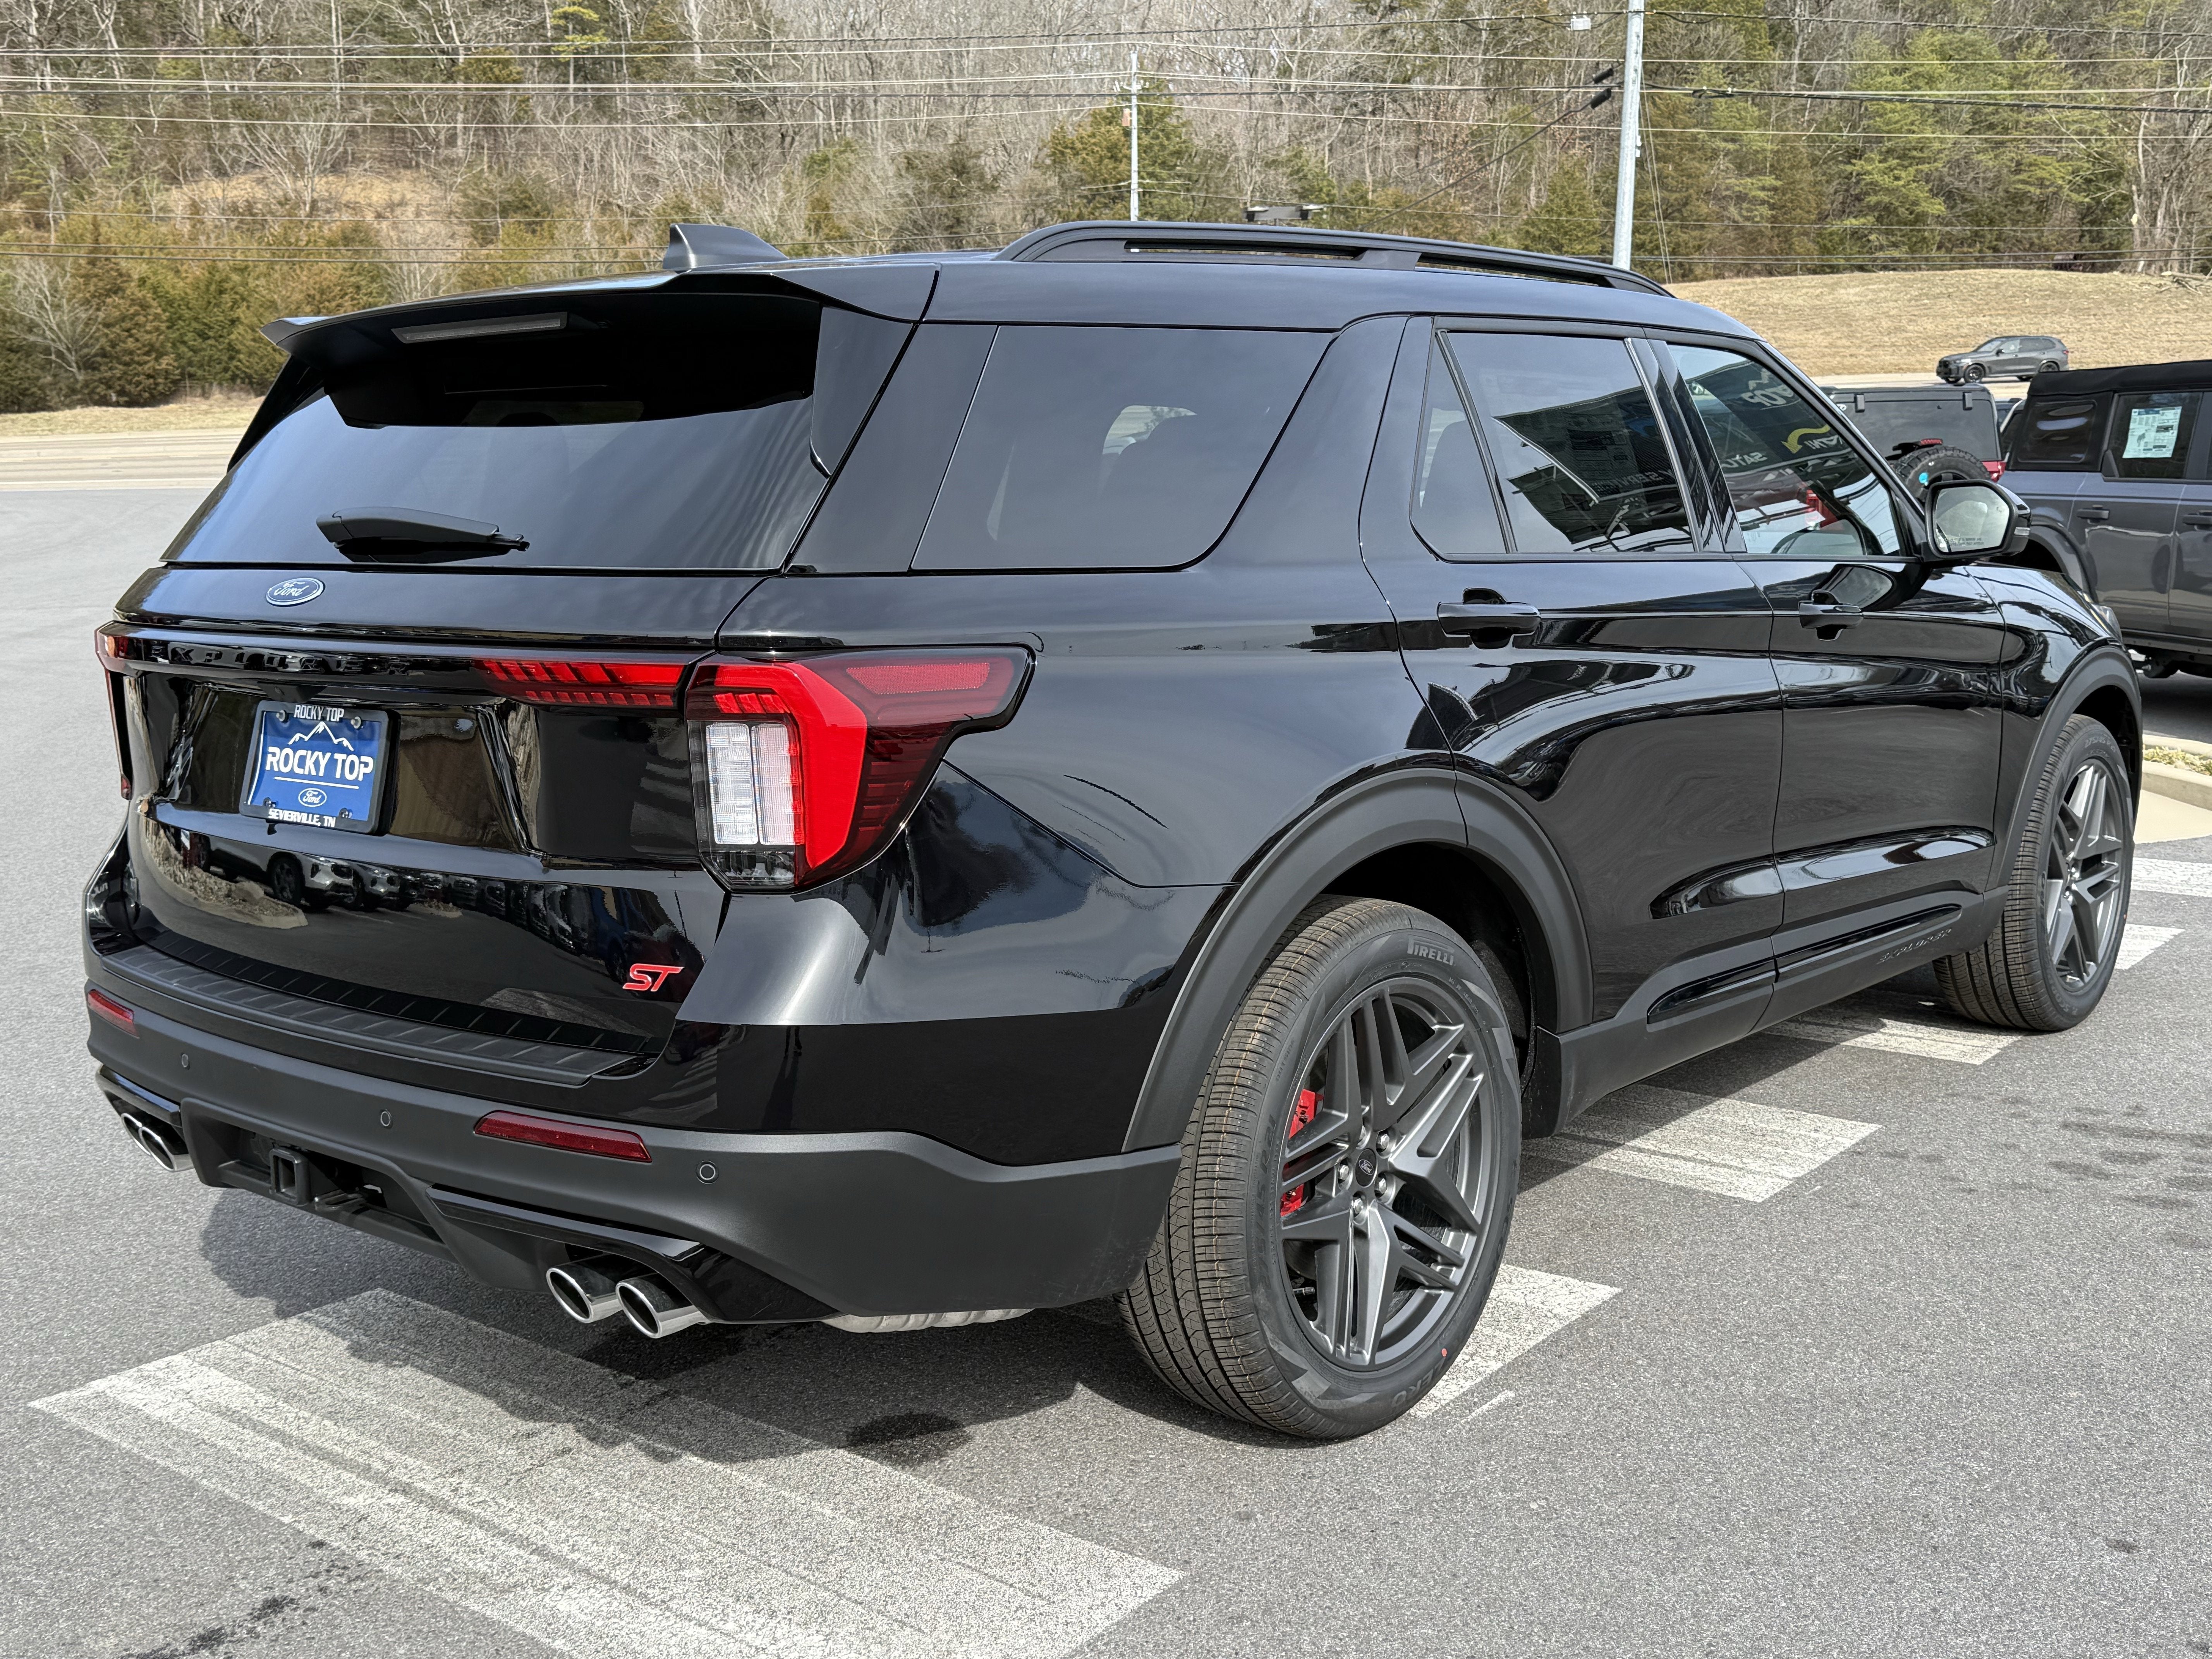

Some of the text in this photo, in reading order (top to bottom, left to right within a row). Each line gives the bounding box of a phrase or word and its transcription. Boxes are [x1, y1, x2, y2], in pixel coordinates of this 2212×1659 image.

[274, 581, 309, 597] Ford
[294, 705, 344, 721] ROCKY TOP
[265, 747, 373, 781] ROCKY TOP
[304, 790, 321, 804] Ford
[268, 808, 336, 828] SEVIERVILLE, TN
[1407, 934, 1456, 966] PIRELLI
[622, 963, 685, 992] ST
[1361, 1161, 1372, 1173] Ford
